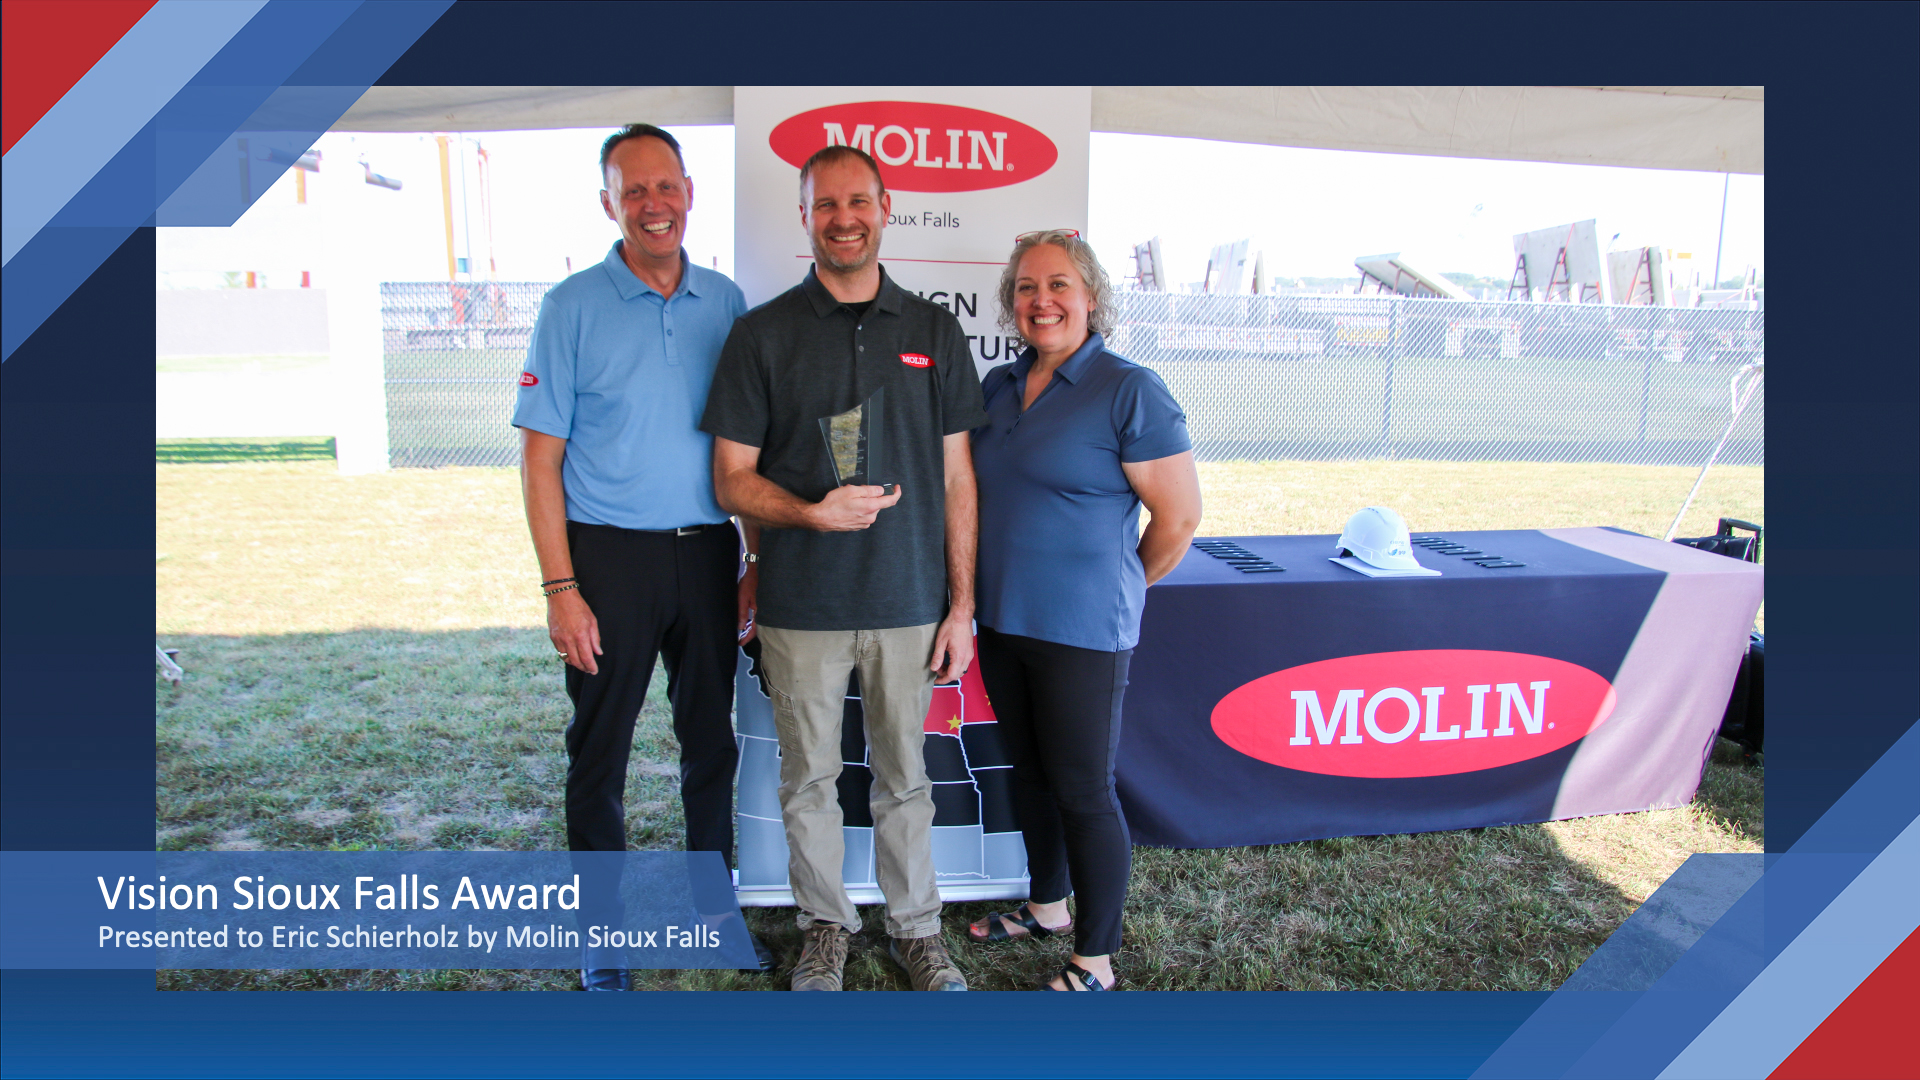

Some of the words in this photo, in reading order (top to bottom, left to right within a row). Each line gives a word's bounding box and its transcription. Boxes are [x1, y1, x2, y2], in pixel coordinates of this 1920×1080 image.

[887, 214, 917, 226] oux
[923, 211, 960, 228] Falls
[902, 355, 929, 366] MOLIN
[1289, 680, 1551, 746] MOLIN
